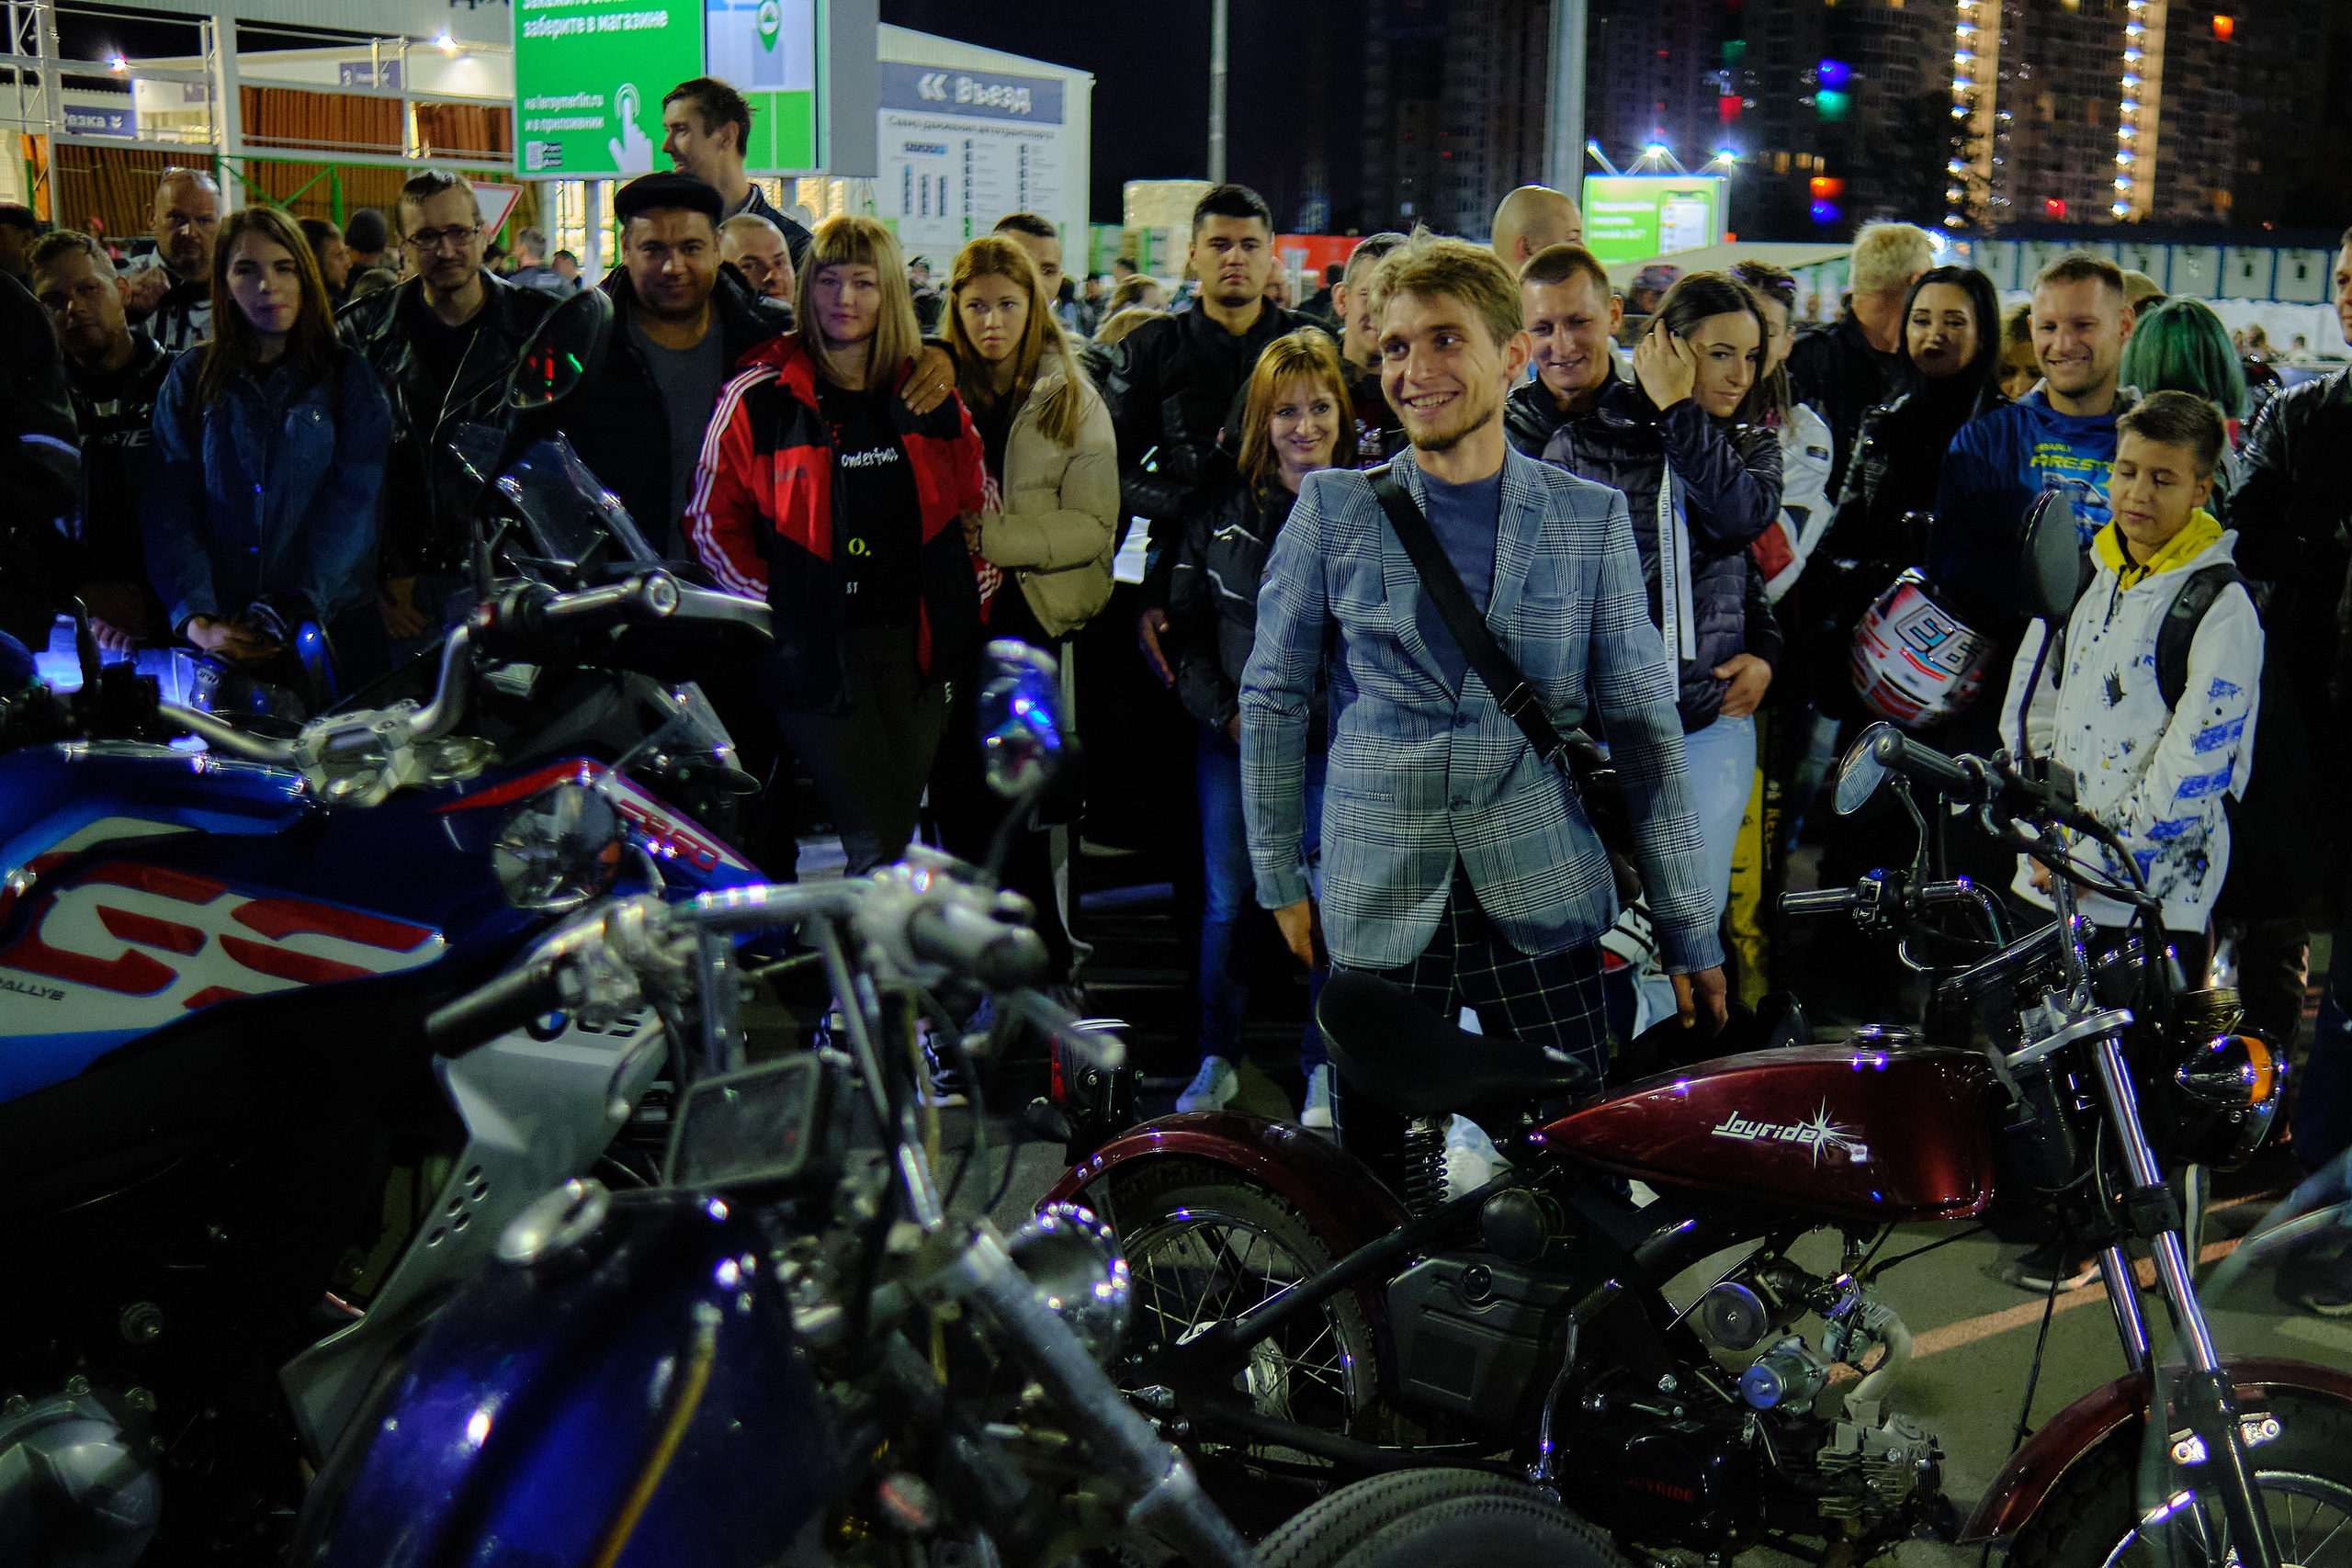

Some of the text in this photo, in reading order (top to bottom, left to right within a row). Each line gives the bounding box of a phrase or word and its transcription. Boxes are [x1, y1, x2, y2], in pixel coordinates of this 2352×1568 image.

[523, 10, 669, 40] заберите в магазине
[956, 76, 1032, 115] Въезд
[63, 113, 107, 129] езка
[1662, 528, 1672, 554] STAR
[1663, 556, 1674, 589] NORTH
[1667, 626, 1677, 660] NORTH
[1712, 1110, 1818, 1144] Joyride
